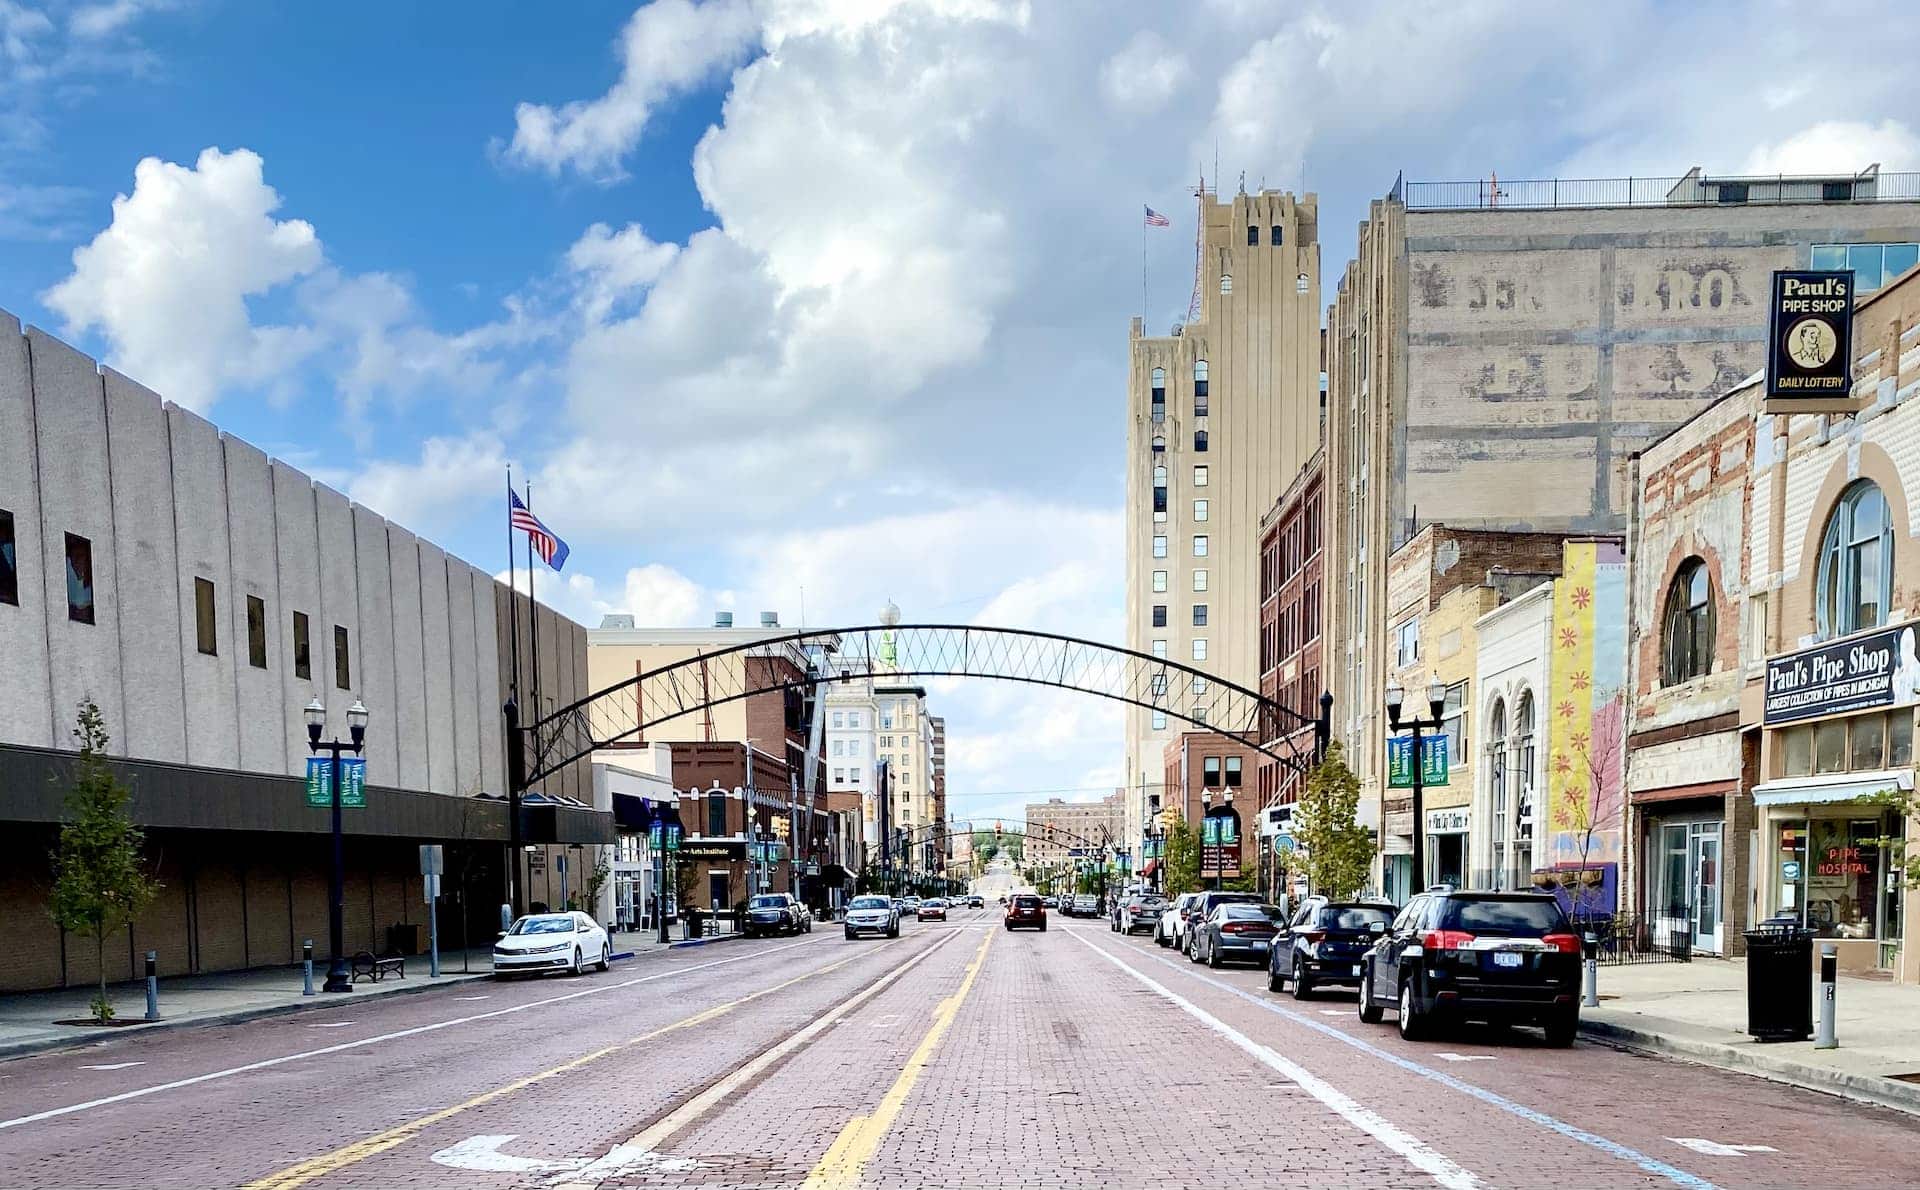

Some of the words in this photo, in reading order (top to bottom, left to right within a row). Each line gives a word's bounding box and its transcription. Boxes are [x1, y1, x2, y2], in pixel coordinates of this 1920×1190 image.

[1783, 278, 1846, 296] Paul's
[1782, 299, 1810, 313] PIPE
[1811, 299, 1846, 313] SHOP
[1778, 376, 1804, 388] DAILY
[1804, 376, 1844, 388] LOTTERY
[1768, 660, 1808, 692] Paul's
[1811, 654, 1844, 685] Pipe
[1848, 644, 1890, 674] Shop
[1766, 696, 1790, 710] LARGEST
[1790, 688, 1824, 706] COLLECTION
[1824, 687, 1833, 700] OF
[1832, 684, 1850, 699] PIPES
[1850, 680, 1858, 695] IN
[1858, 675, 1890, 693] MICHIGAN
[1391, 742, 1400, 776] Welcome
[1401, 741, 1411, 776] Welcome
[1424, 740, 1434, 775] Welcome
[1435, 739, 1445, 774] Welcome
[321, 762, 331, 796] Welcome
[352, 763, 362, 797] Welcome
[703, 847, 729, 855] Institute
[1829, 847, 1860, 859] PIPE
[1818, 863, 1871, 874] HOSPITAL
